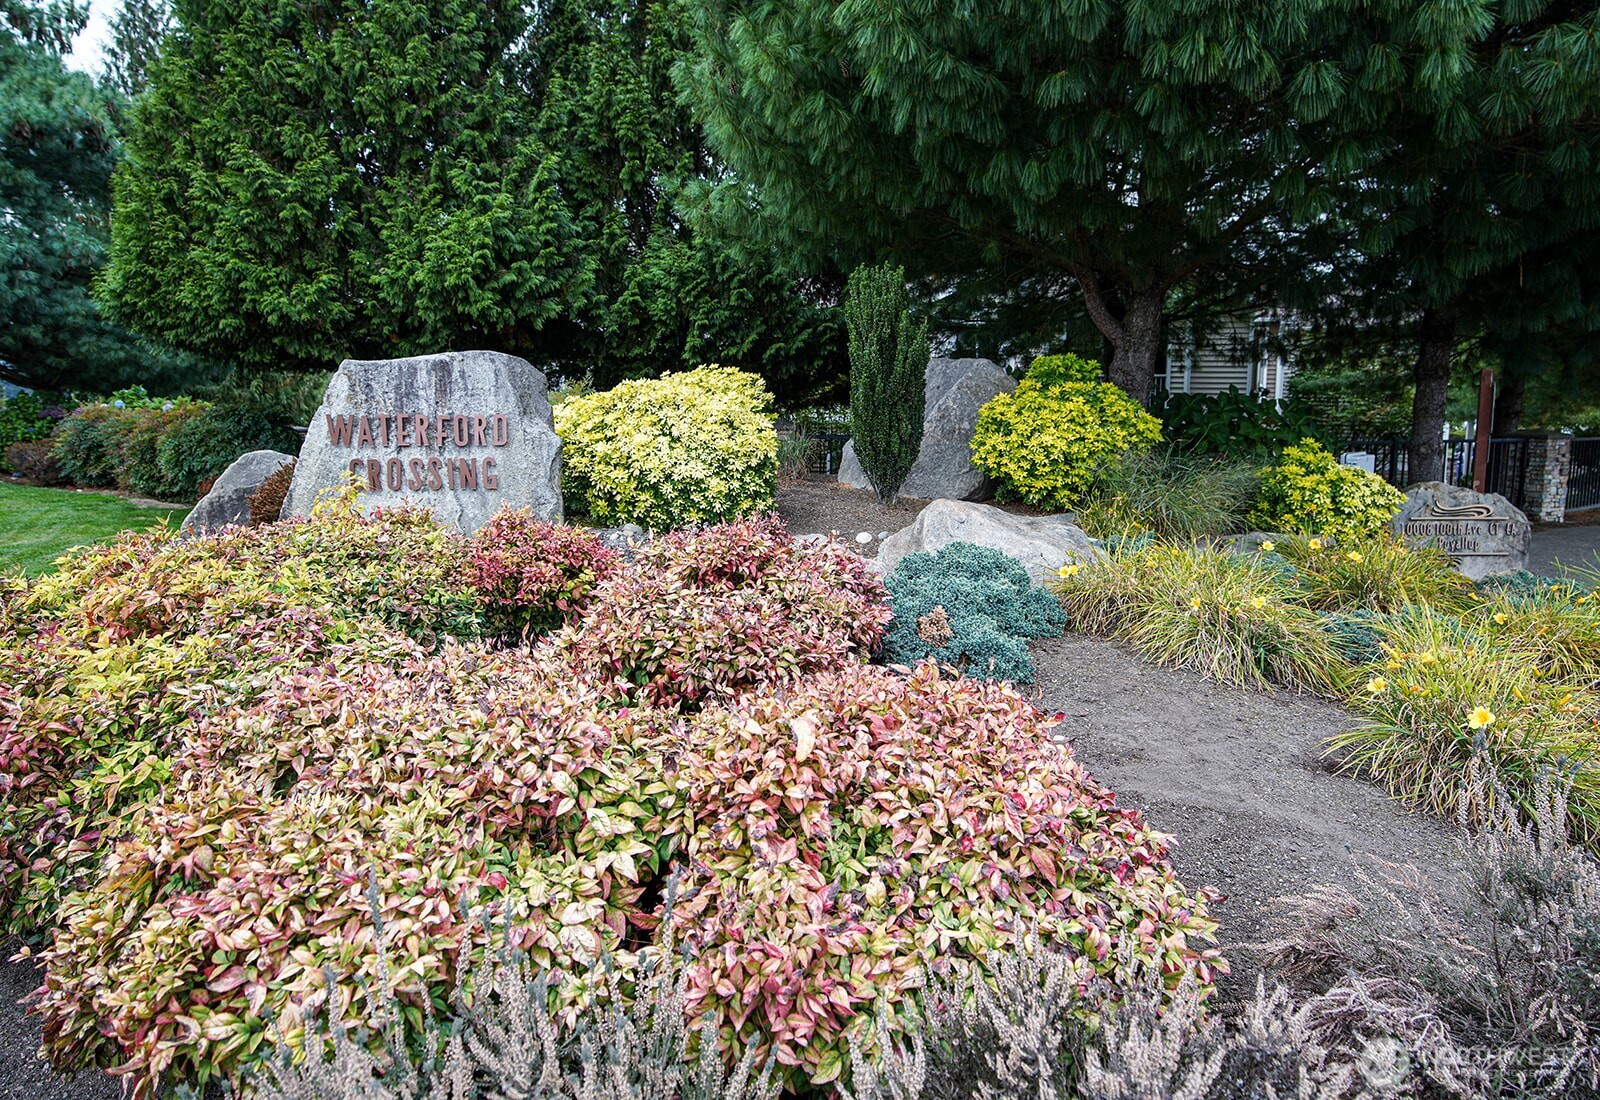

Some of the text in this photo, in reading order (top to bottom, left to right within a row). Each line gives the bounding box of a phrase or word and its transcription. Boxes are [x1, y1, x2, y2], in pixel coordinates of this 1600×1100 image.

[325, 414, 508, 447] WATERFORD
[350, 457, 497, 491] CROSSING
[1466, 522, 1481, 535] Ave
[1489, 522, 1499, 535] CT
